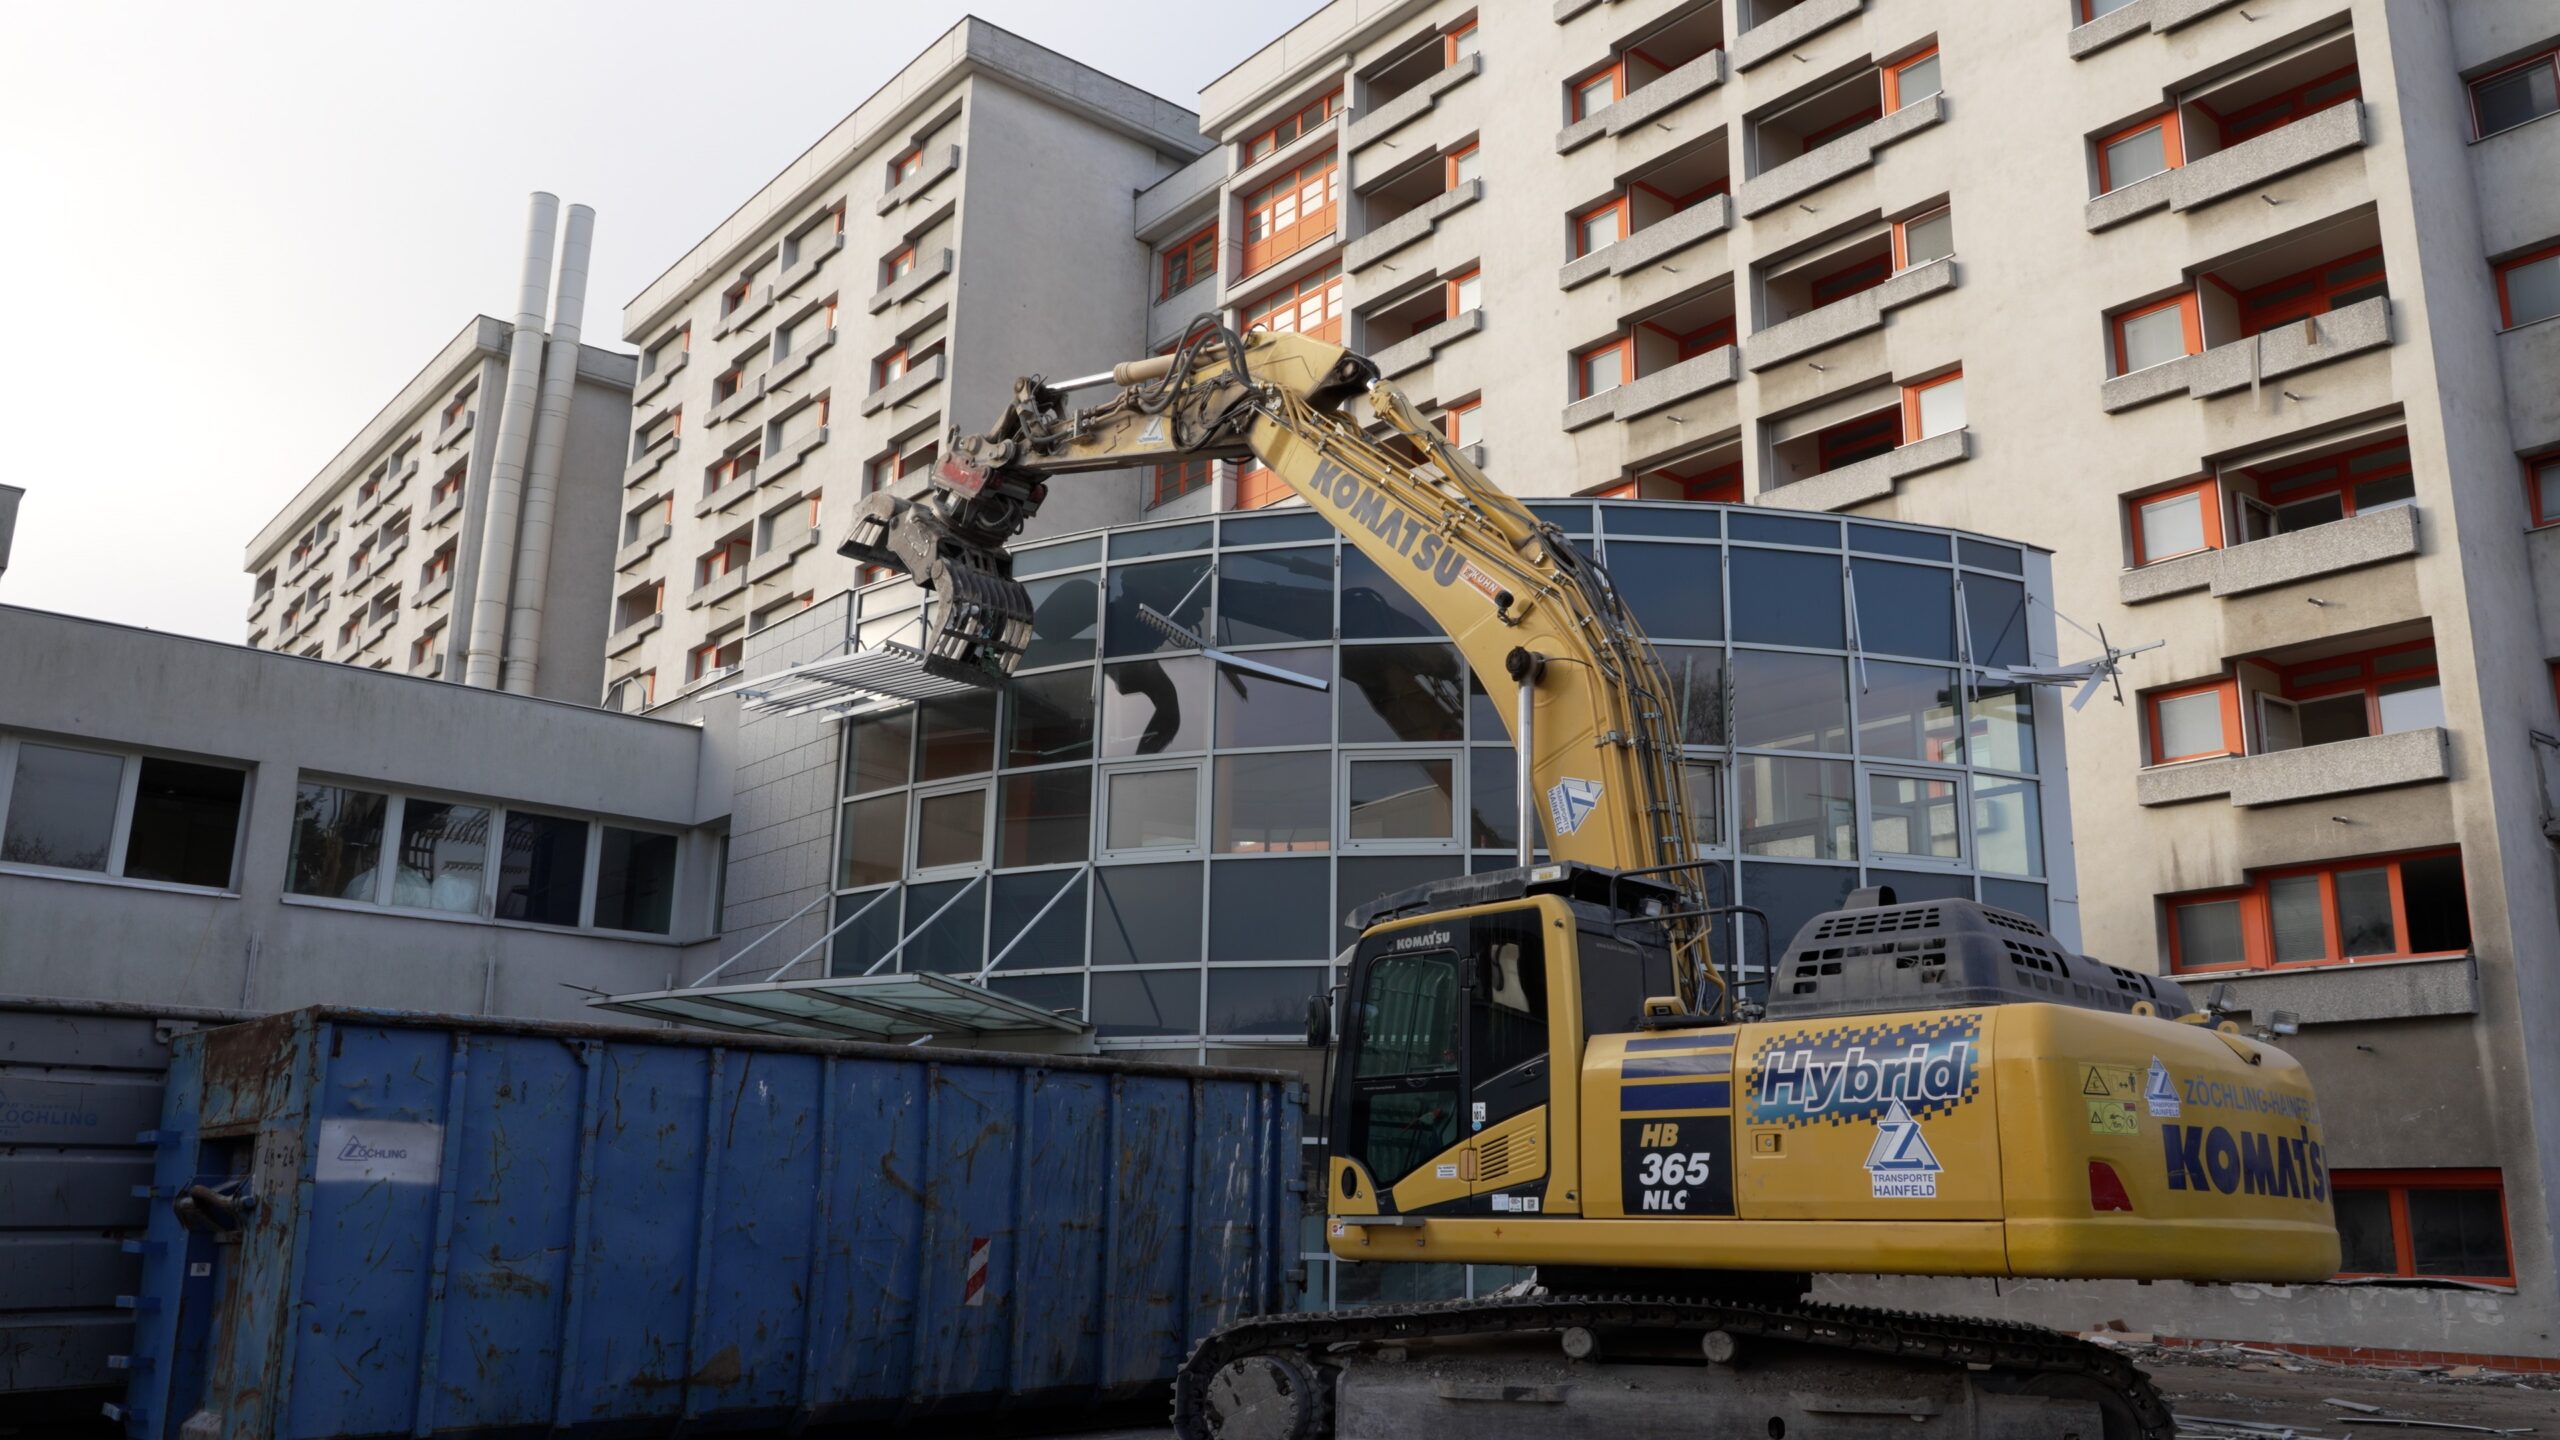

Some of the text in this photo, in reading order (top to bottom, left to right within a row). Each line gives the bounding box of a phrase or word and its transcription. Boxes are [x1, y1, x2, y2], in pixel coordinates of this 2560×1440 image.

[1309, 457, 1467, 587] KOMATSU
[1548, 789, 1564, 833] HAINFELD
[1556, 786, 1570, 830] TRANSPORTE
[1396, 931, 1451, 950] KOMATSU
[1760, 1040, 1970, 1112] Hybrid
[2184, 1075, 2320, 1125] ZÖCHLING-HAINFEL
[1640, 1123, 1680, 1147] HB
[1639, 1152, 1711, 1186] 365
[1873, 1173, 1934, 1183] TRANSPORTE
[1642, 1189, 1688, 1210] NLC
[1873, 1185, 1935, 1196] HAINFELD
